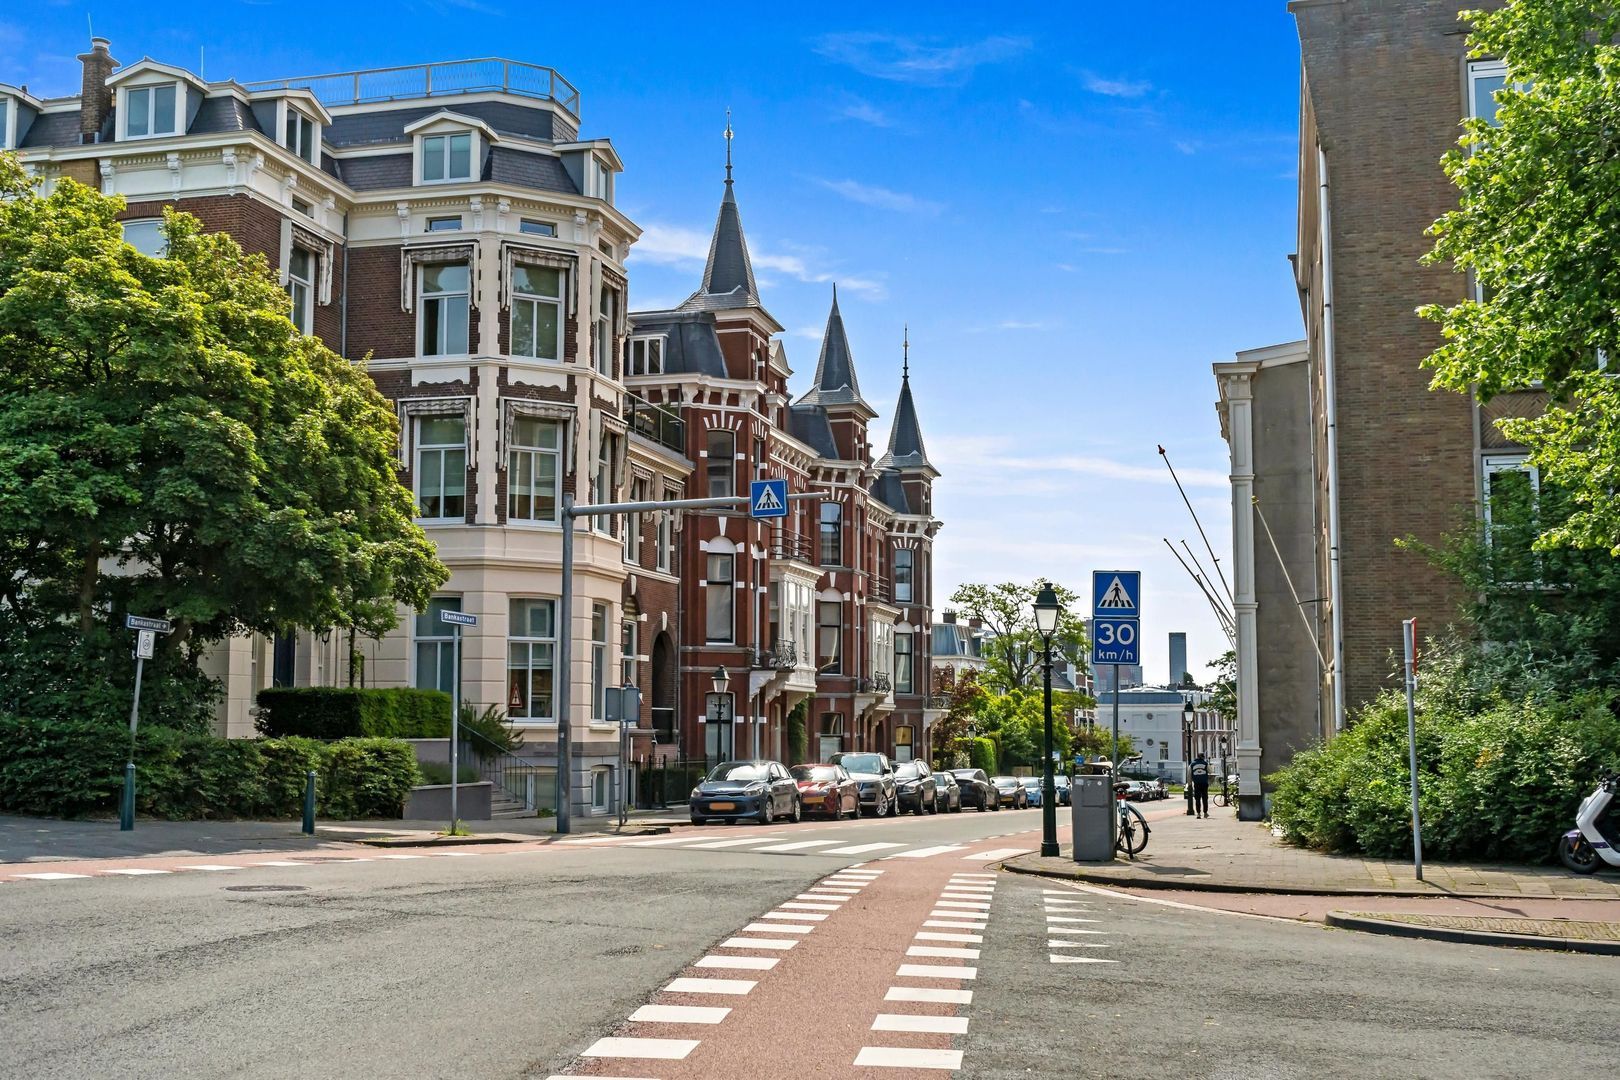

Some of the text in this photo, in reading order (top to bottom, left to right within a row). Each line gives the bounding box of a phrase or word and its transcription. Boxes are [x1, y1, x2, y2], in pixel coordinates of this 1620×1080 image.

[130, 618, 161, 628] Bankastraat
[444, 612, 475, 623] Bankastraat
[1098, 623, 1135, 645] 30
[1098, 649, 1133, 661] km/h
